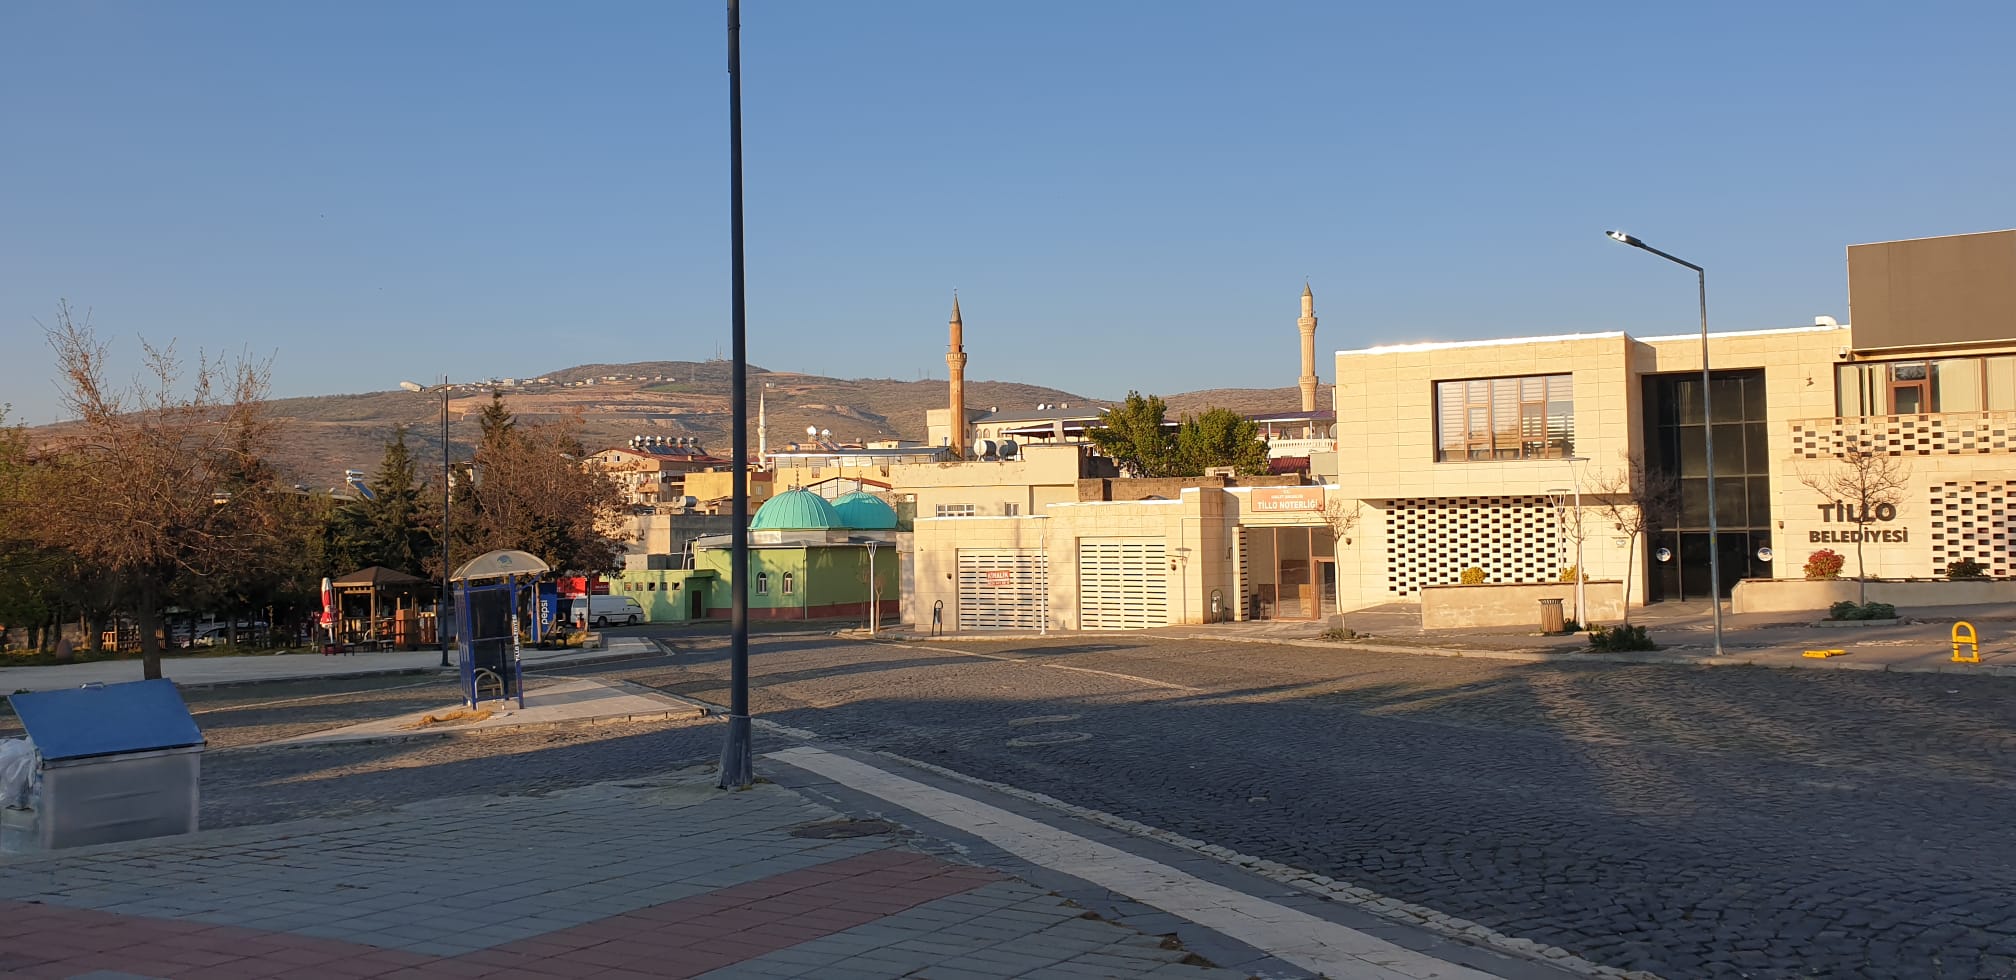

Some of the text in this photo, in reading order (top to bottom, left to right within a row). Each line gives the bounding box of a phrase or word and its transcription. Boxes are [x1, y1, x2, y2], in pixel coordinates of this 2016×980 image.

[1817, 499, 1896, 522] TİLLO
[1809, 527, 1908, 543] BELEDİYESİ
[541, 600, 549, 625] pepsi
